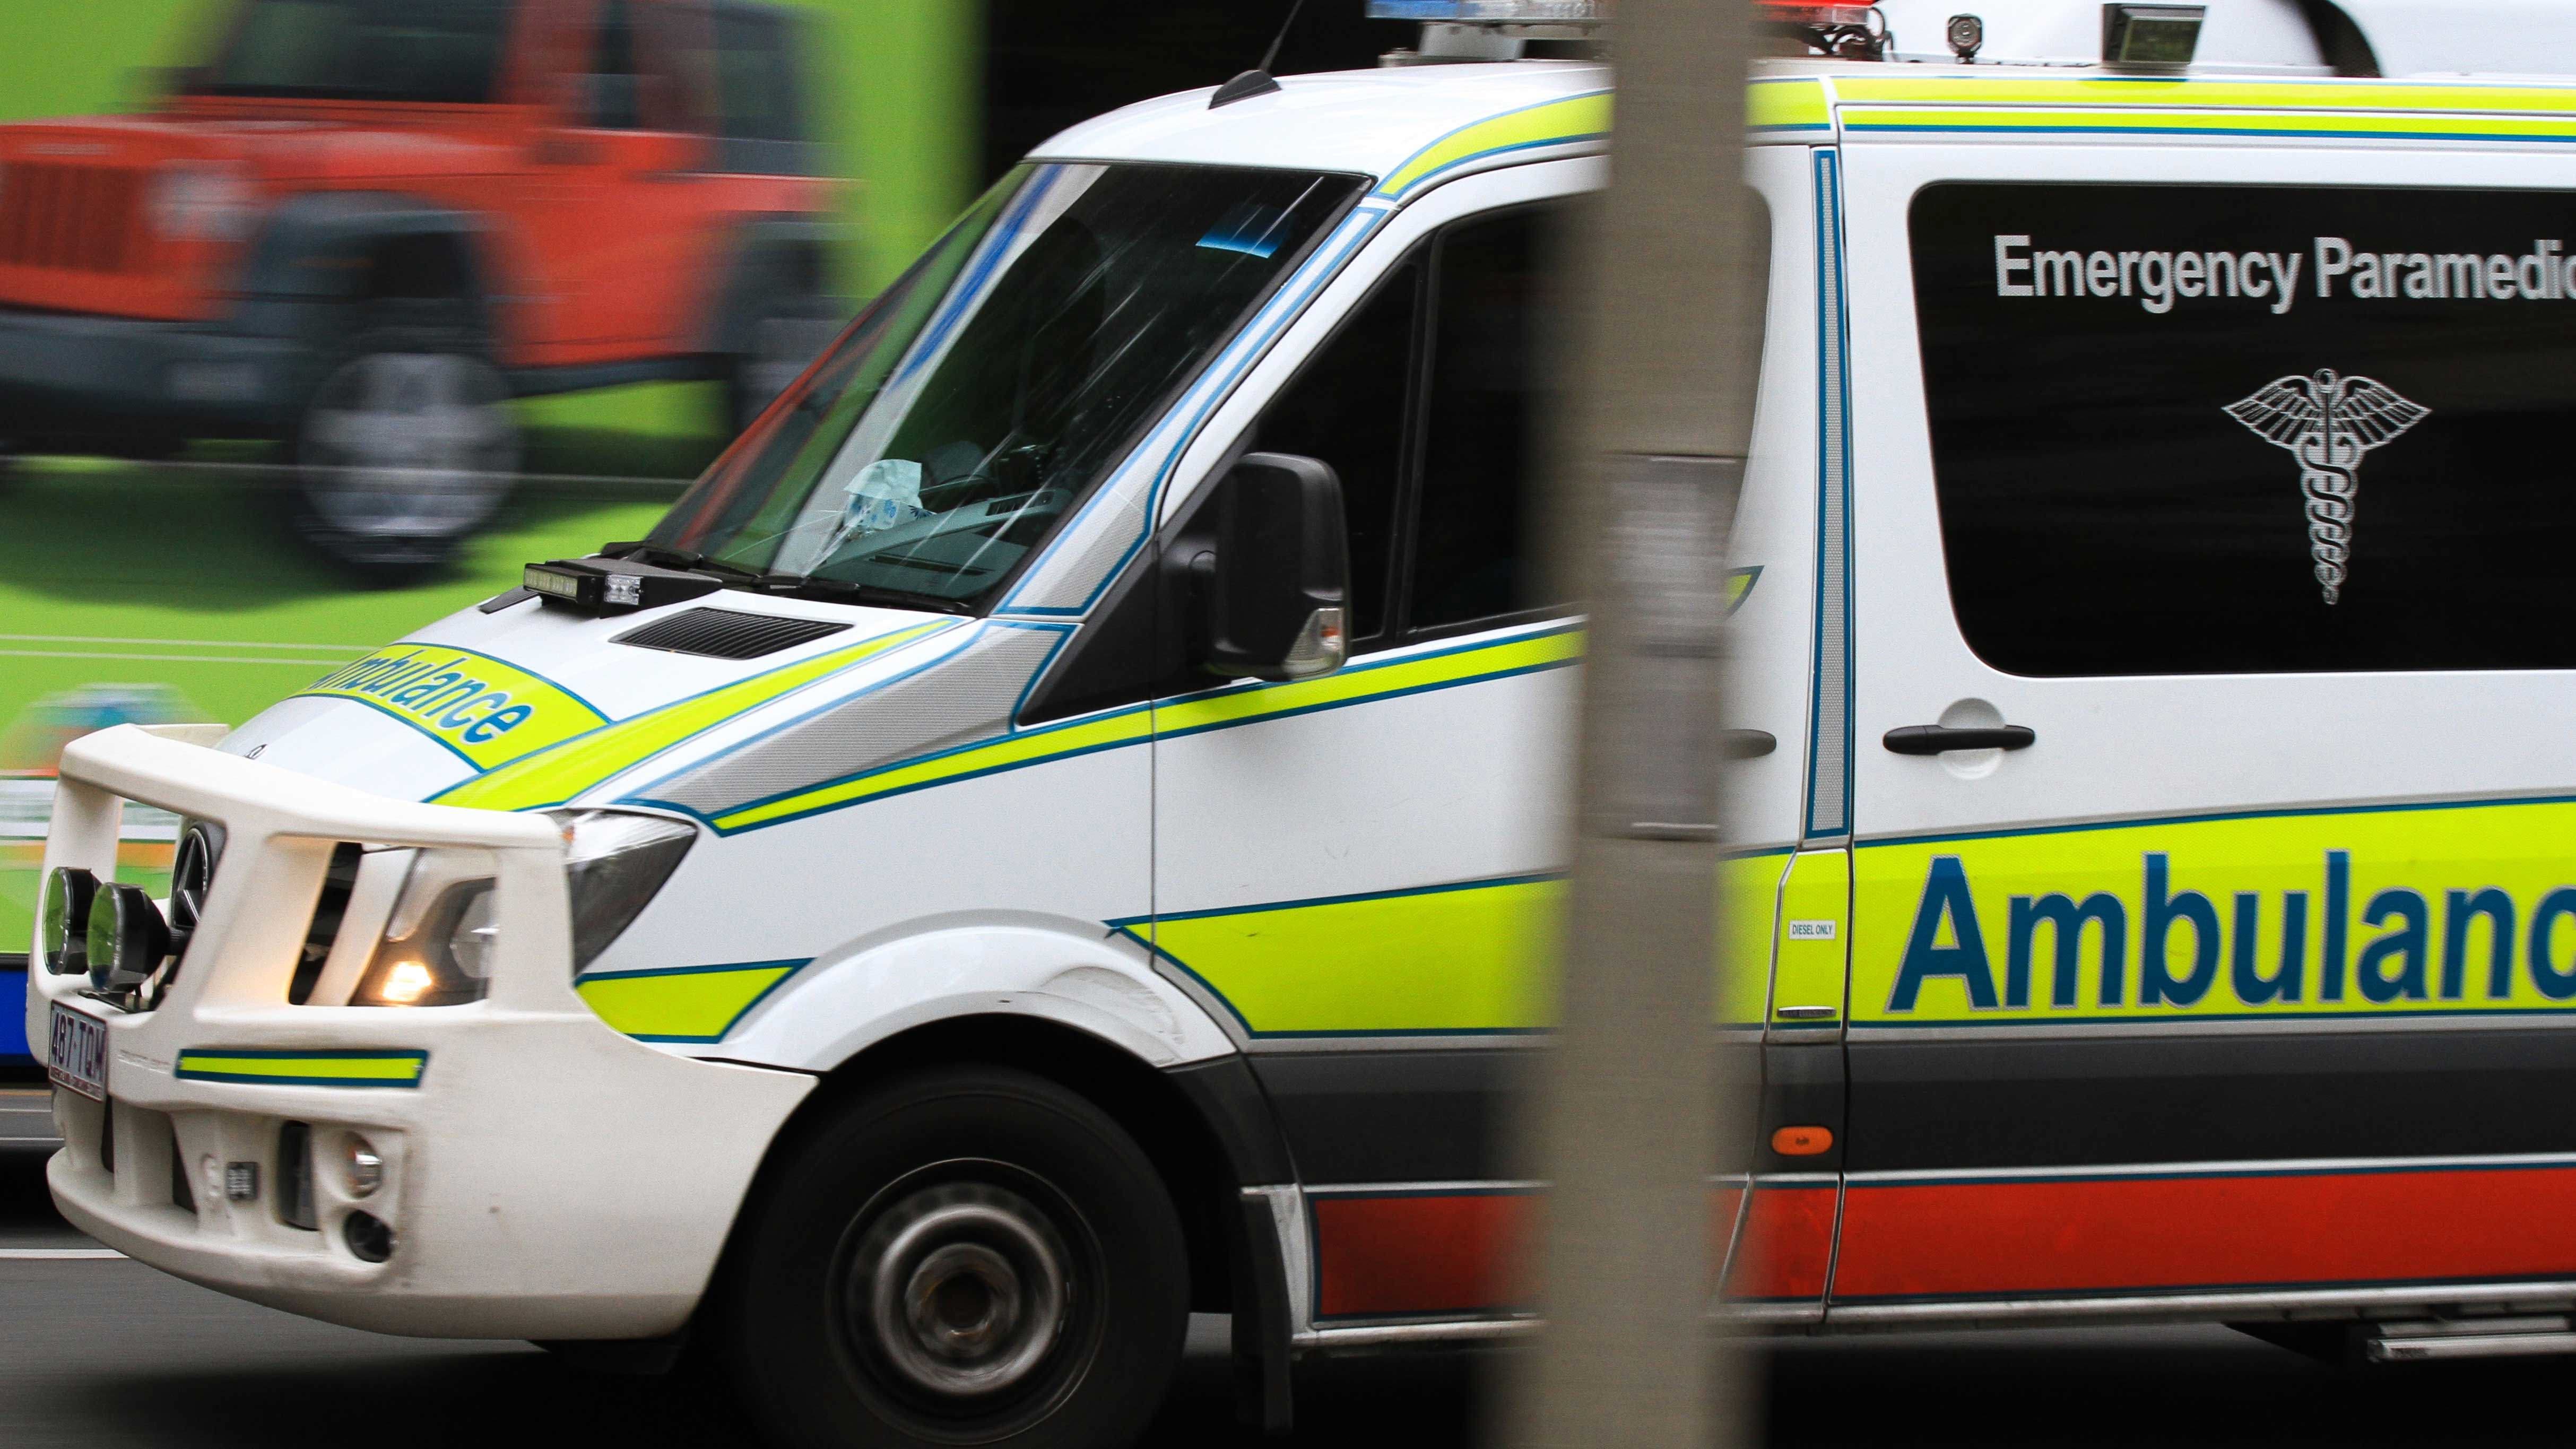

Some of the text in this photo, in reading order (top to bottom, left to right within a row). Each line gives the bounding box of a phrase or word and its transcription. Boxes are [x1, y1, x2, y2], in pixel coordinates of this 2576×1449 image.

[1994, 235, 2303, 314] Emergency
[1792, 924, 1833, 934] DIESEL ONLY
[1883, 848, 2576, 1013] Ambulanc
